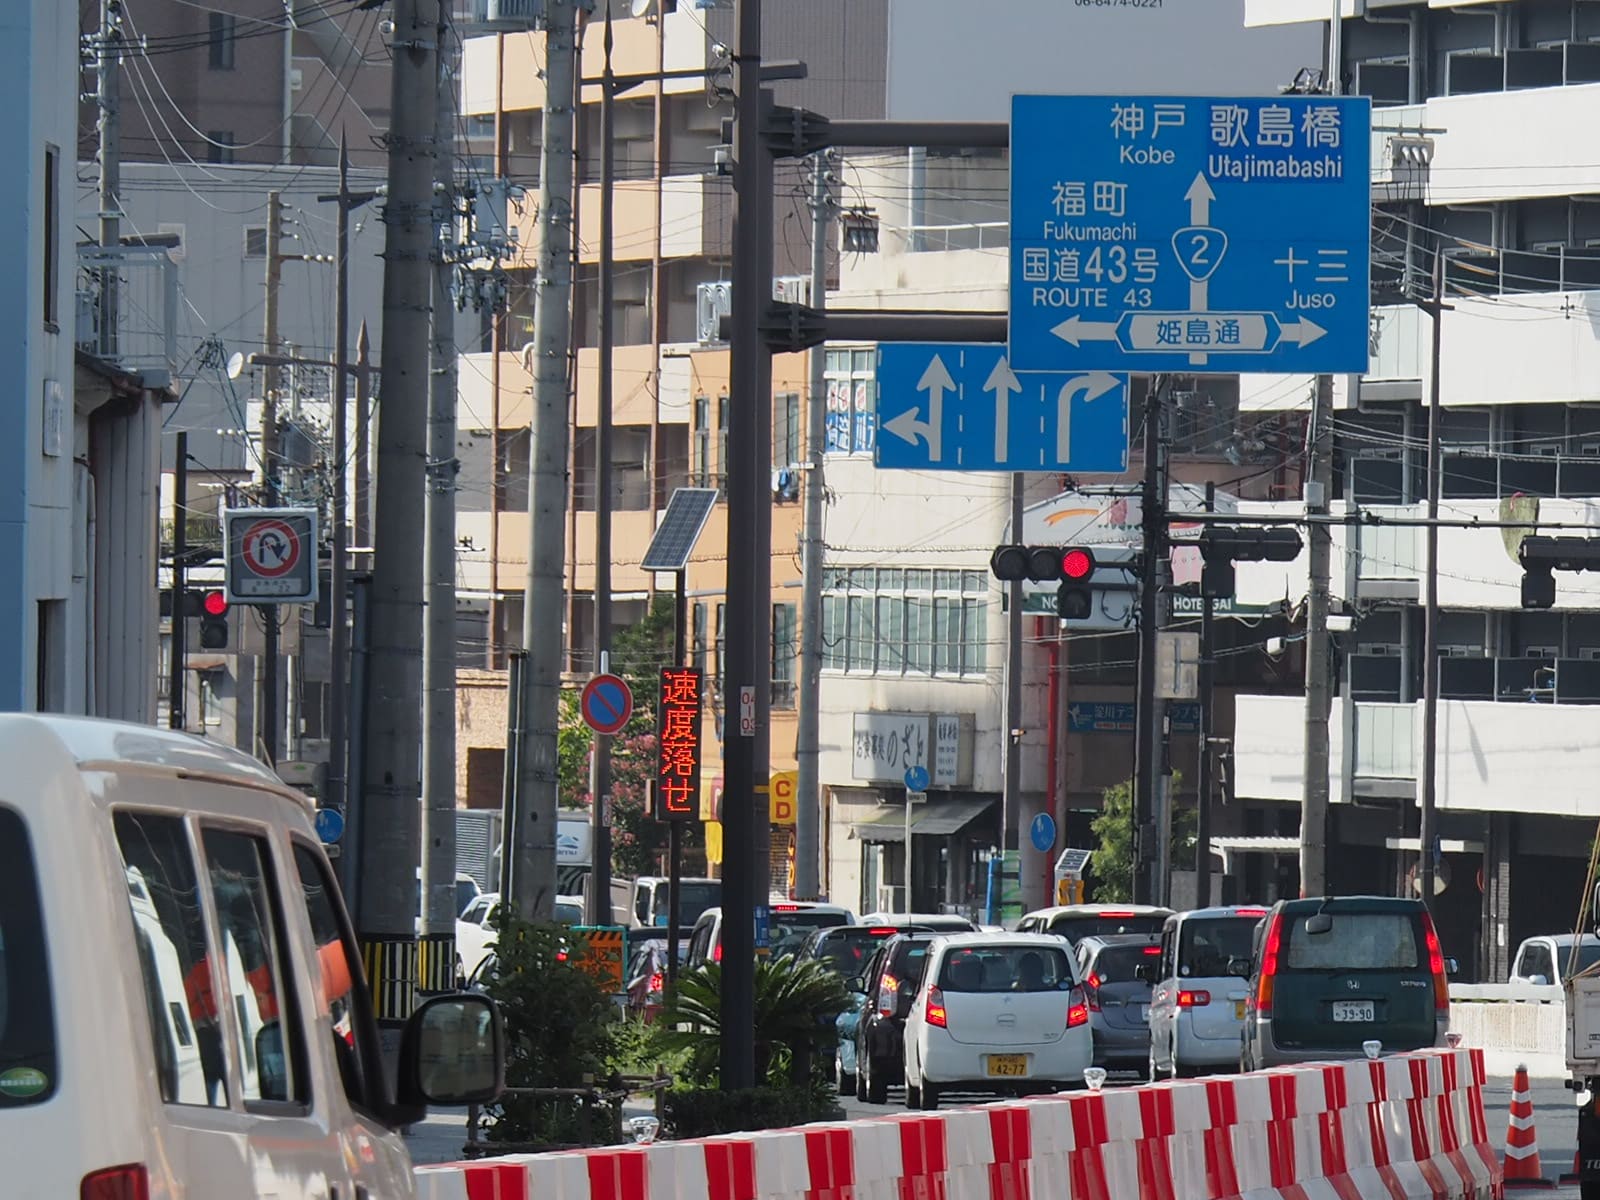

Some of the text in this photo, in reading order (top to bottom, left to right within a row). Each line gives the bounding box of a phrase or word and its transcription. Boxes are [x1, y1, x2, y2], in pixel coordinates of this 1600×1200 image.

[1110, 102, 1186, 140] 神戸
[1210, 103, 1341, 148] 歌島橋
[1119, 145, 1176, 165] Kobe
[1208, 154, 1342, 182] Utajimabashi
[1052, 180, 1128, 216] 福町
[1043, 221, 1136, 241] Fukumachi
[1023, 245, 1159, 283] 国道43号
[1191, 236, 1209, 264] 2
[1273, 247, 1348, 283] 十三
[1033, 287, 1152, 307] ROUTE 43
[1285, 290, 1336, 309] Juso
[1156, 318, 1241, 345] 姫島通
[661, 671, 698, 812] 速度落せ
[775, 780, 791, 819] CD
